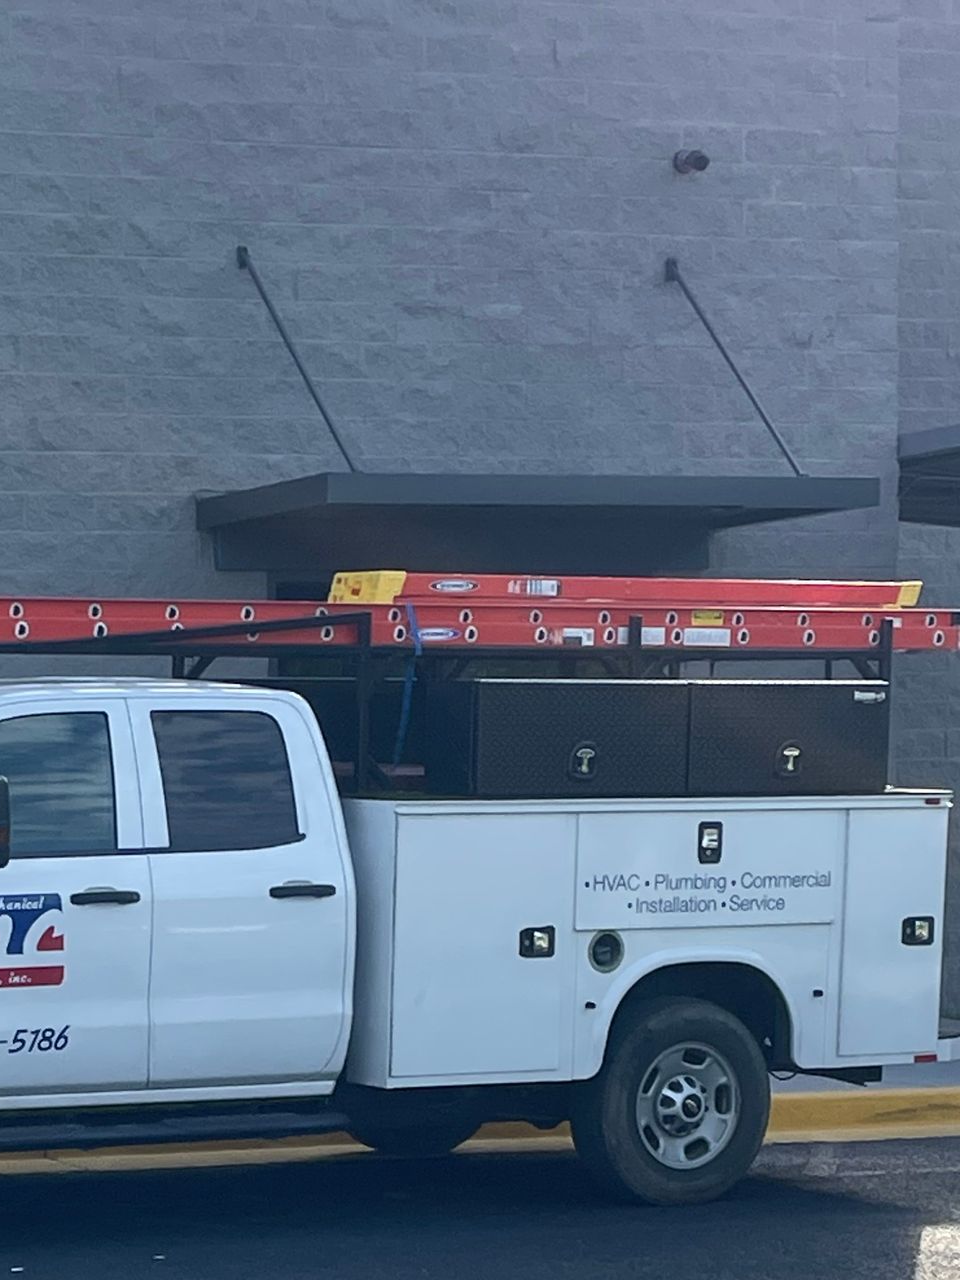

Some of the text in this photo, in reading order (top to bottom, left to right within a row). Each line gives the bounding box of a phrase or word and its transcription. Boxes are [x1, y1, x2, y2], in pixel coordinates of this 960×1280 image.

[593, 871, 831, 893] HVAC Plumbing Commercial
[635, 894, 785, 914] Installation Service
[8, 972, 32, 984] inc.
